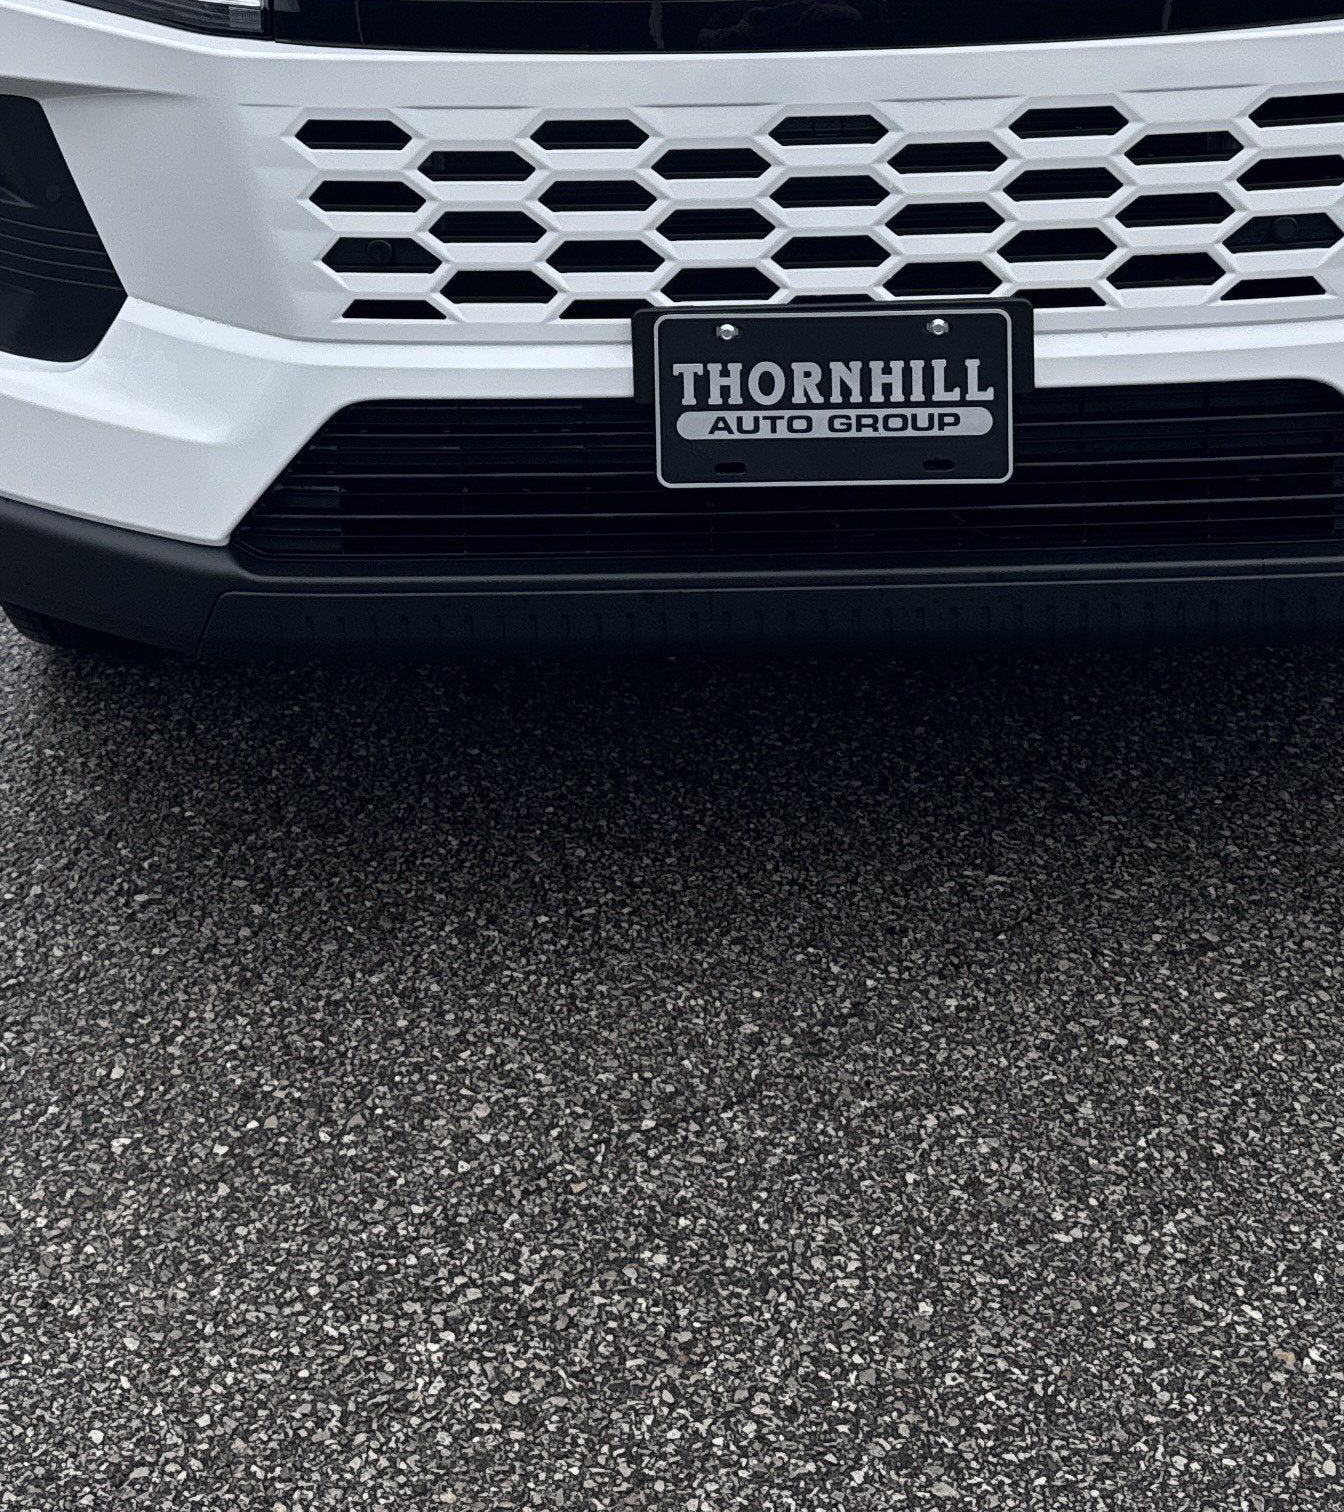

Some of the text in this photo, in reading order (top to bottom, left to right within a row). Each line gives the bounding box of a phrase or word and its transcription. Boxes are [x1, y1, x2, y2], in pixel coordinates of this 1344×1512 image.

[672, 358, 994, 406] THORNHILL
[708, 412, 961, 435] AUTO GROUP
